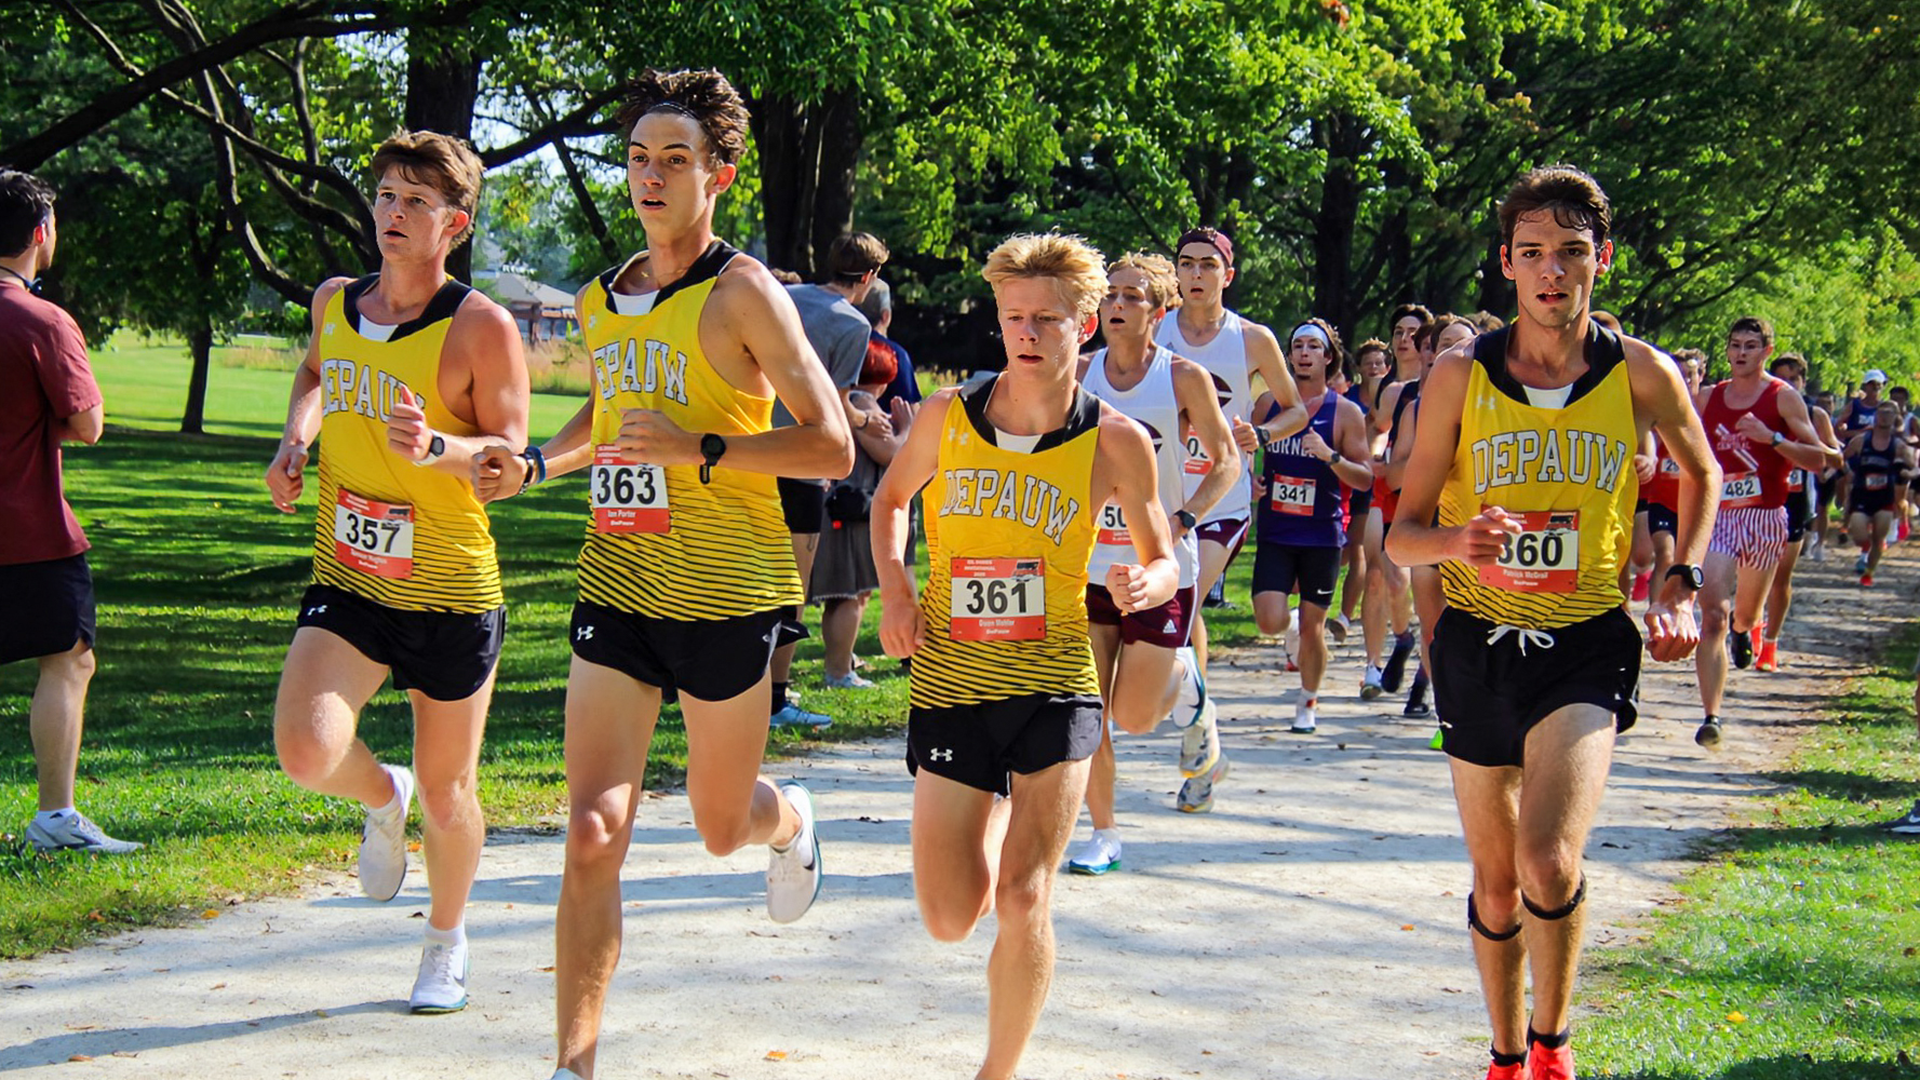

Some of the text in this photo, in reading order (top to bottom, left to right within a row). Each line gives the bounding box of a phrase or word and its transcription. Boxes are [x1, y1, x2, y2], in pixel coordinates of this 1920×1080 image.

[320, 358, 426, 423] EPAU
[593, 338, 688, 406] EPAUW
[1471, 429, 1626, 495] DEPAUW
[597, 467, 656, 505] 363
[1279, 484, 1307, 503] 341
[1725, 480, 1755, 497] 482
[939, 467, 1079, 546] DEPAUW
[346, 513, 401, 553] 357
[1497, 532, 1563, 567] 360
[966, 579, 1027, 615] 361
